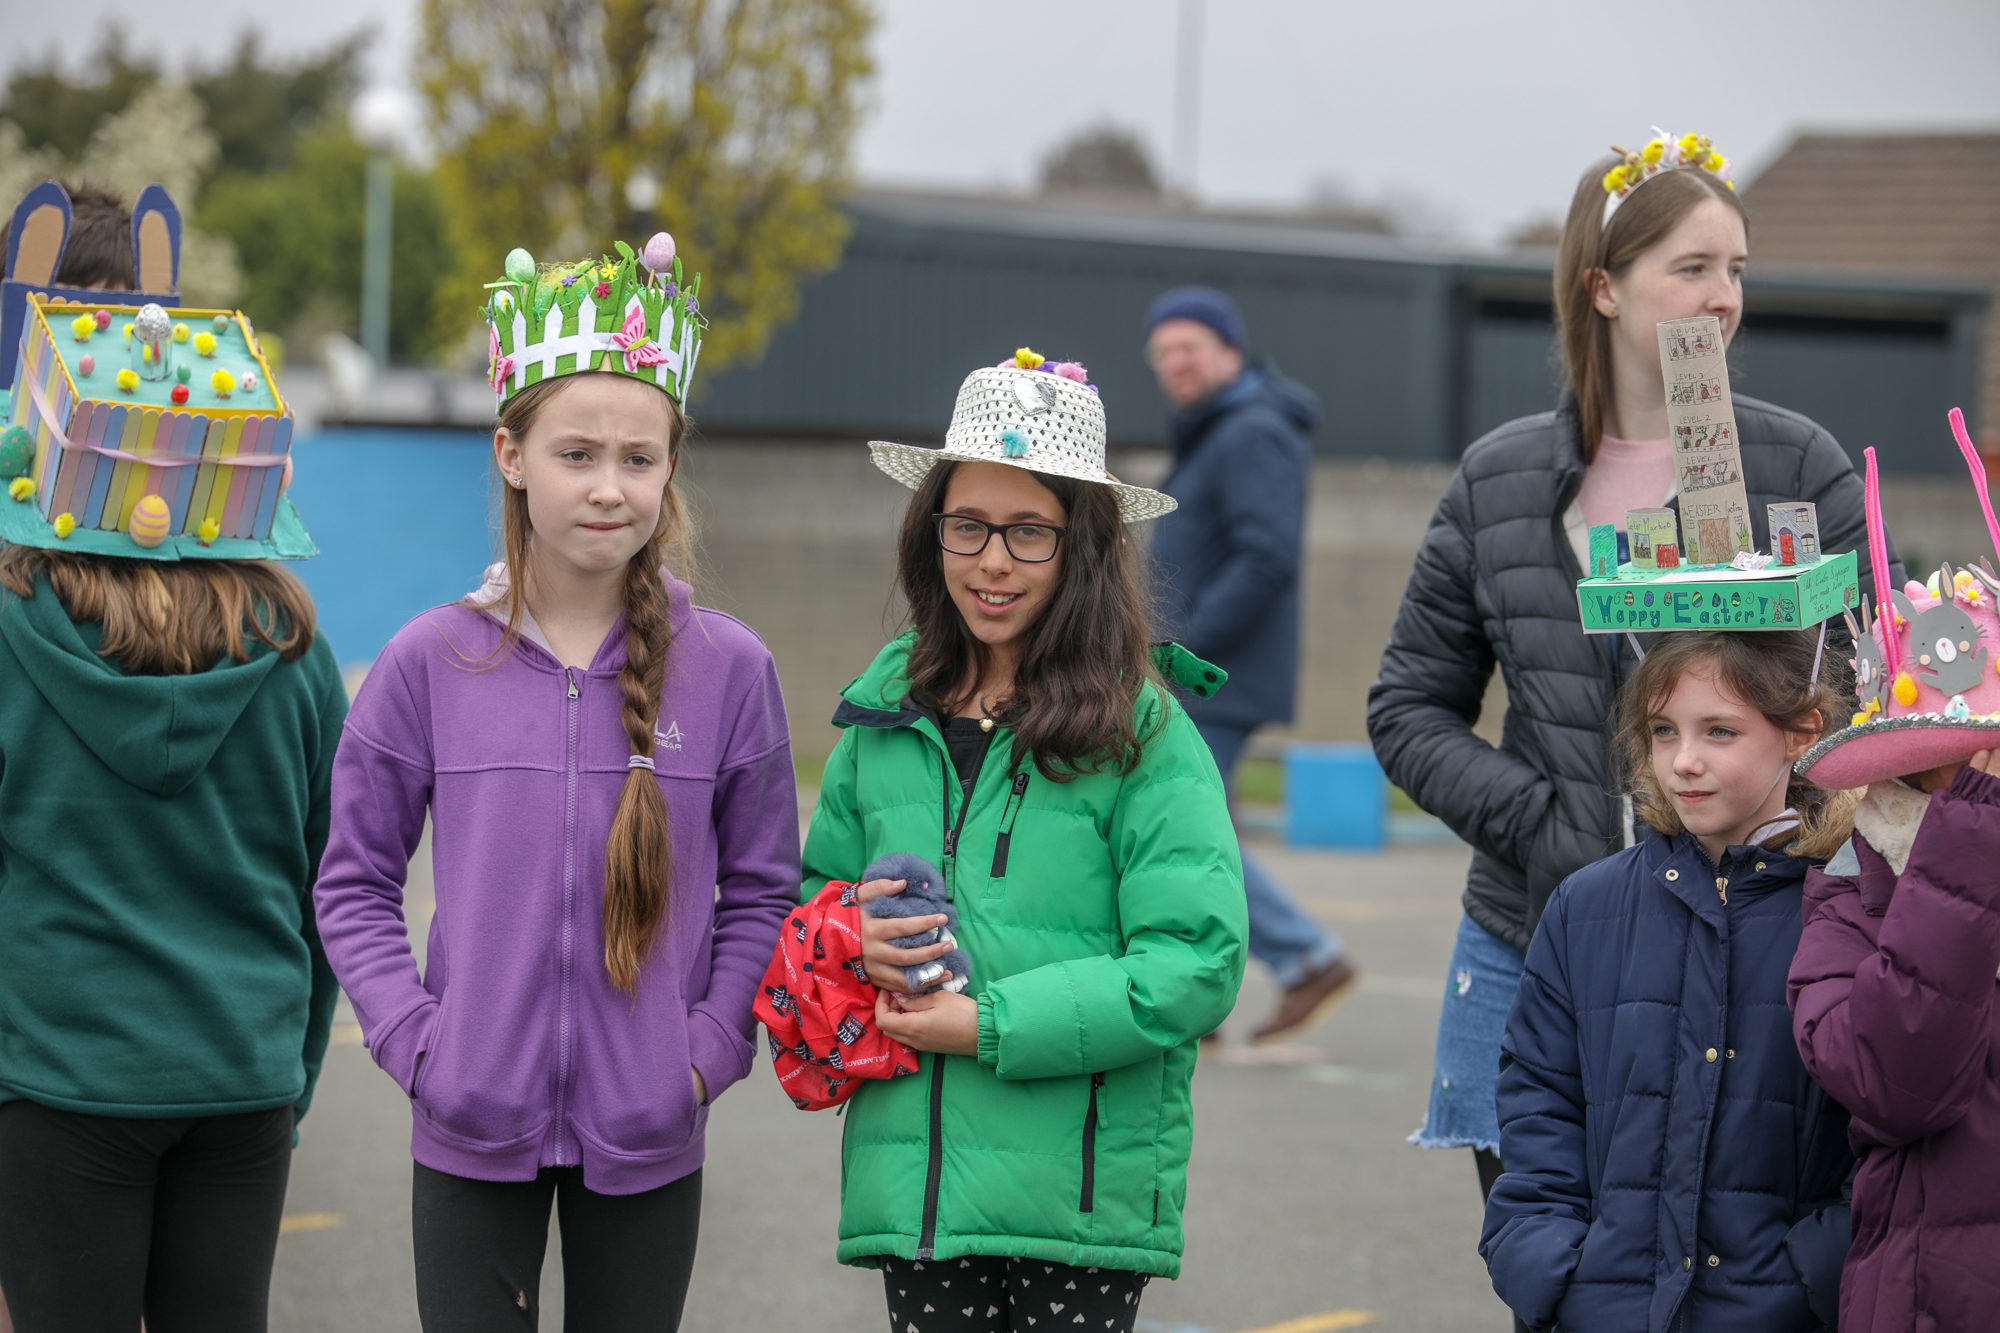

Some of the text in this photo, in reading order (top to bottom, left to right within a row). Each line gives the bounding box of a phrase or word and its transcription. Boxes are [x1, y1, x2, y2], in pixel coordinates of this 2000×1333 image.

[1675, 372, 1696, 381] LEVEL
[1679, 415, 1703, 424] LEVEL
[1686, 456, 1712, 465] LEVEL
[1688, 503, 1720, 518] EASTER
[1596, 591, 1769, 627] Happy Easter!
[654, 716, 685, 742] LA
[653, 737, 682, 752] GEAR
[772, 987, 785, 1007] HELL
[837, 1026, 855, 1046] HELL
